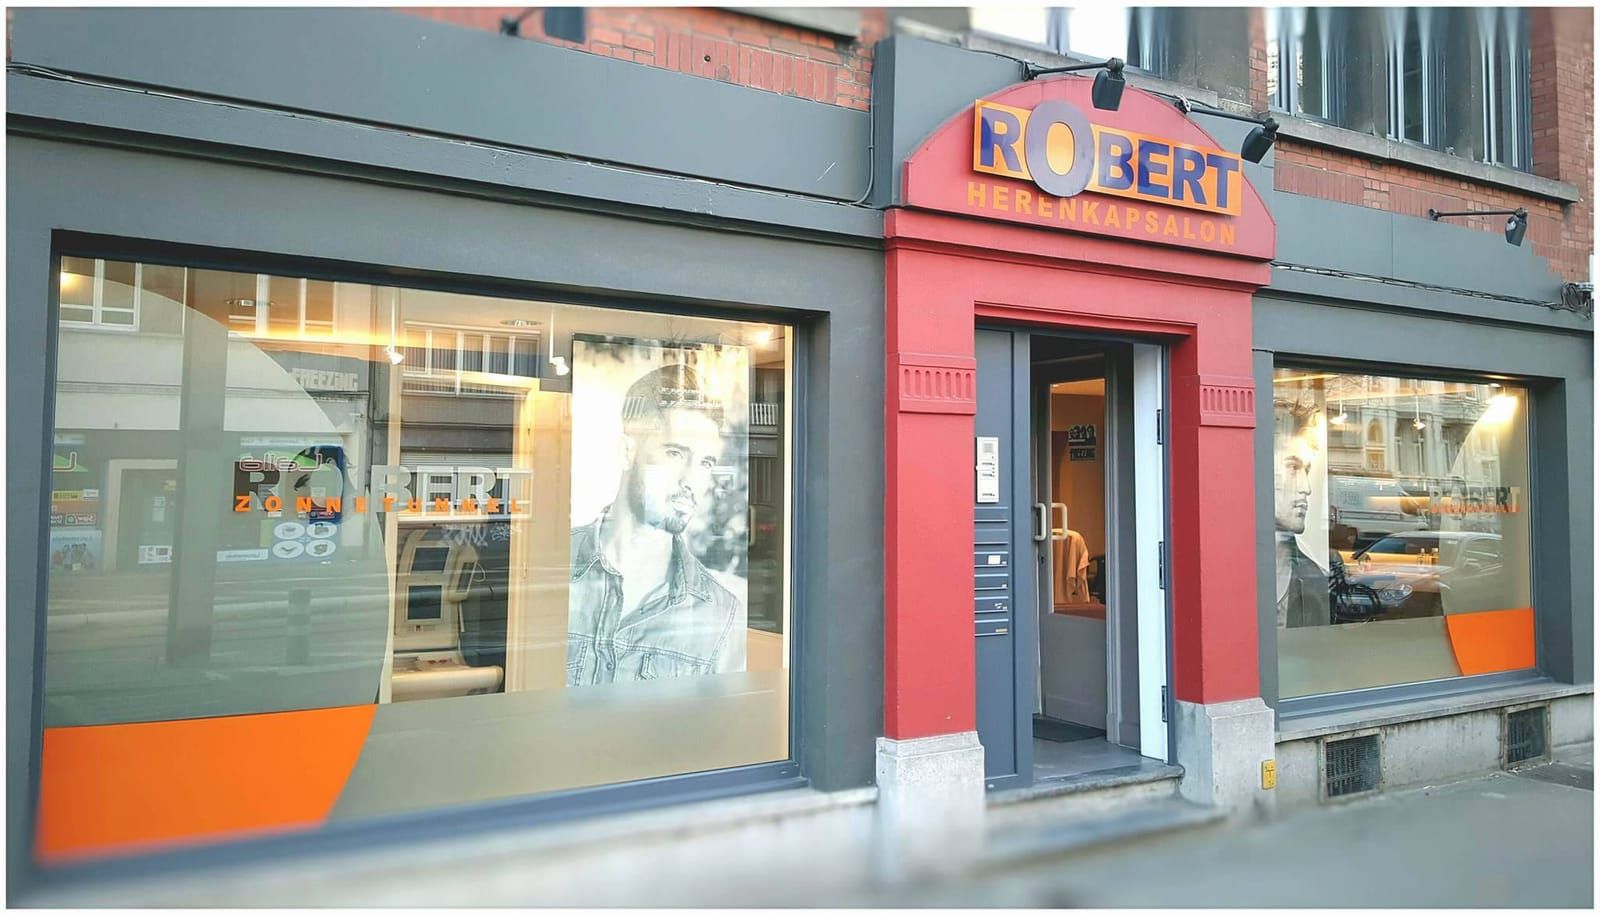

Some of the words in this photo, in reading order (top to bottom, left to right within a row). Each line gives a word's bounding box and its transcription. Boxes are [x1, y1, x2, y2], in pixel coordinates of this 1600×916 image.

[979, 100, 1239, 208] ROBERT
[967, 182, 1236, 246] HERENKAPSALON
[234, 446, 536, 525] ROBERT
[234, 495, 523, 513] ZONNETUNNEL
